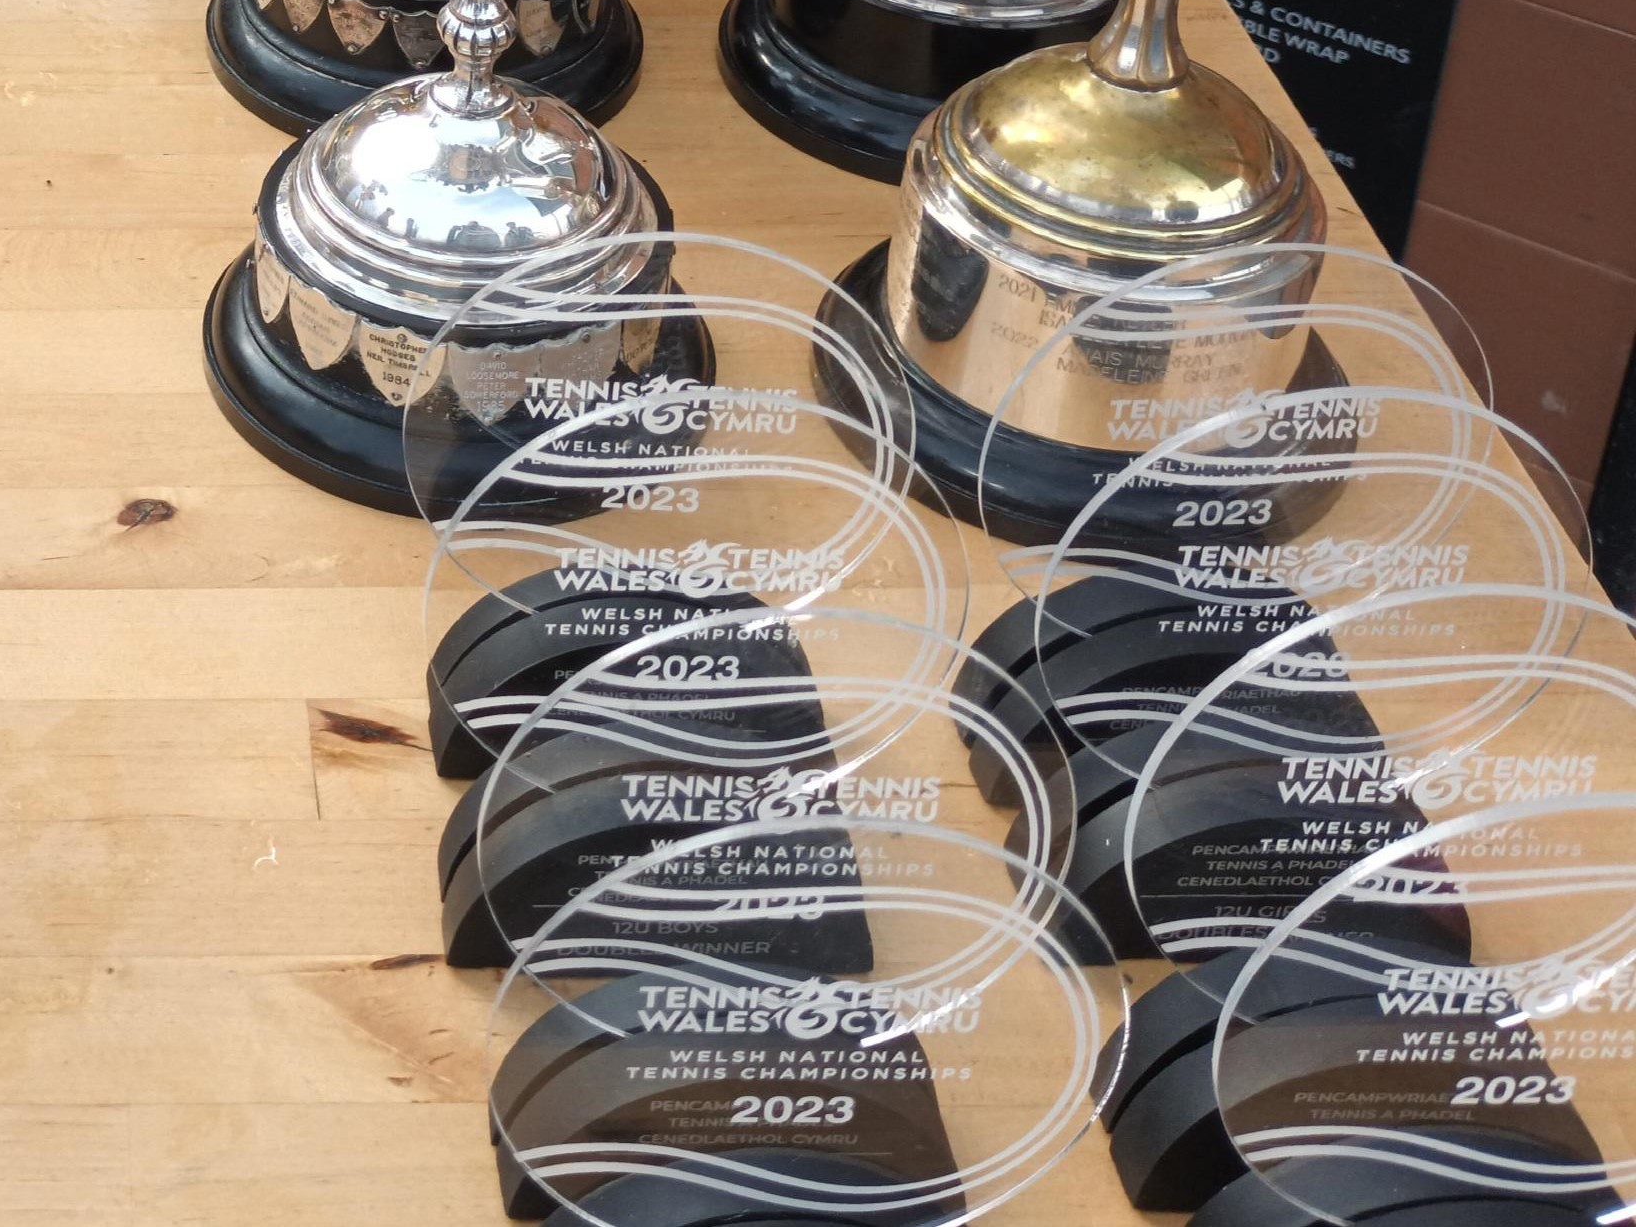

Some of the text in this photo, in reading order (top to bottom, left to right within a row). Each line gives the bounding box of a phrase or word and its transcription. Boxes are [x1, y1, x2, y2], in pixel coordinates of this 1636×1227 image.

[1269, 3, 1413, 66] CONTAINERS
[1283, 26, 1351, 67] WRAP
[382, 371, 411, 387] 1984
[525, 377, 638, 401] TENNIS
[1109, 396, 1382, 421] TENNIS TENNIS
[686, 411, 797, 434] CYMRU
[1268, 418, 1378, 441] CYMRU
[551, 440, 628, 455] WELSH
[600, 485, 700, 513] 2023
[1172, 499, 1273, 527] 2023
[554, 548, 845, 570] TENNIS TENNIS
[1177, 544, 1469, 567] TENNIS TENNIS
[554, 569, 843, 592] WALES CYMRU
[1174, 568, 1286, 589] WALES
[581, 608, 662, 620] WELSH
[1196, 605, 1281, 617] WELSH
[544, 624, 630, 635] TENNIS
[1158, 621, 1244, 633] TENNIS
[636, 654, 740, 682] 2023
[1281, 755, 1599, 780] TENNIS TENNIS
[622, 774, 753, 799] TENNIS
[1277, 780, 1400, 804] WALES
[620, 798, 744, 822] WALES
[1302, 820, 1392, 835] WELSH
[754, 845, 888, 859] NATIONAL
[1260, 838, 1353, 853] TENNIS
[718, 861, 935, 876] CHAMPIONSHIPS
[1206, 859, 1285, 871] TENNIS A
[1176, 876, 1314, 888] CENEDLAETHOL
[612, 921, 719, 934] 12U BOYS
[639, 986, 983, 1010] TENNIS TENNIS
[1377, 991, 1511, 1016] WALES
[637, 1009, 771, 1033] WALES
[1403, 1031, 1497, 1046] WELSH
[669, 1050, 924, 1064] WELSH NATIONAL
[1356, 1049, 1456, 1063] TENNIS
[626, 1066, 972, 1081] TENNIS CHAMPIONSHIPS
[1450, 1075, 1577, 1106] 2023
[729, 1095, 855, 1124] 2023
[1311, 1108, 1476, 1121] TENNIS A PHADEL
[639, 1133, 859, 1146] CENEDLAETHOL CYMRU
